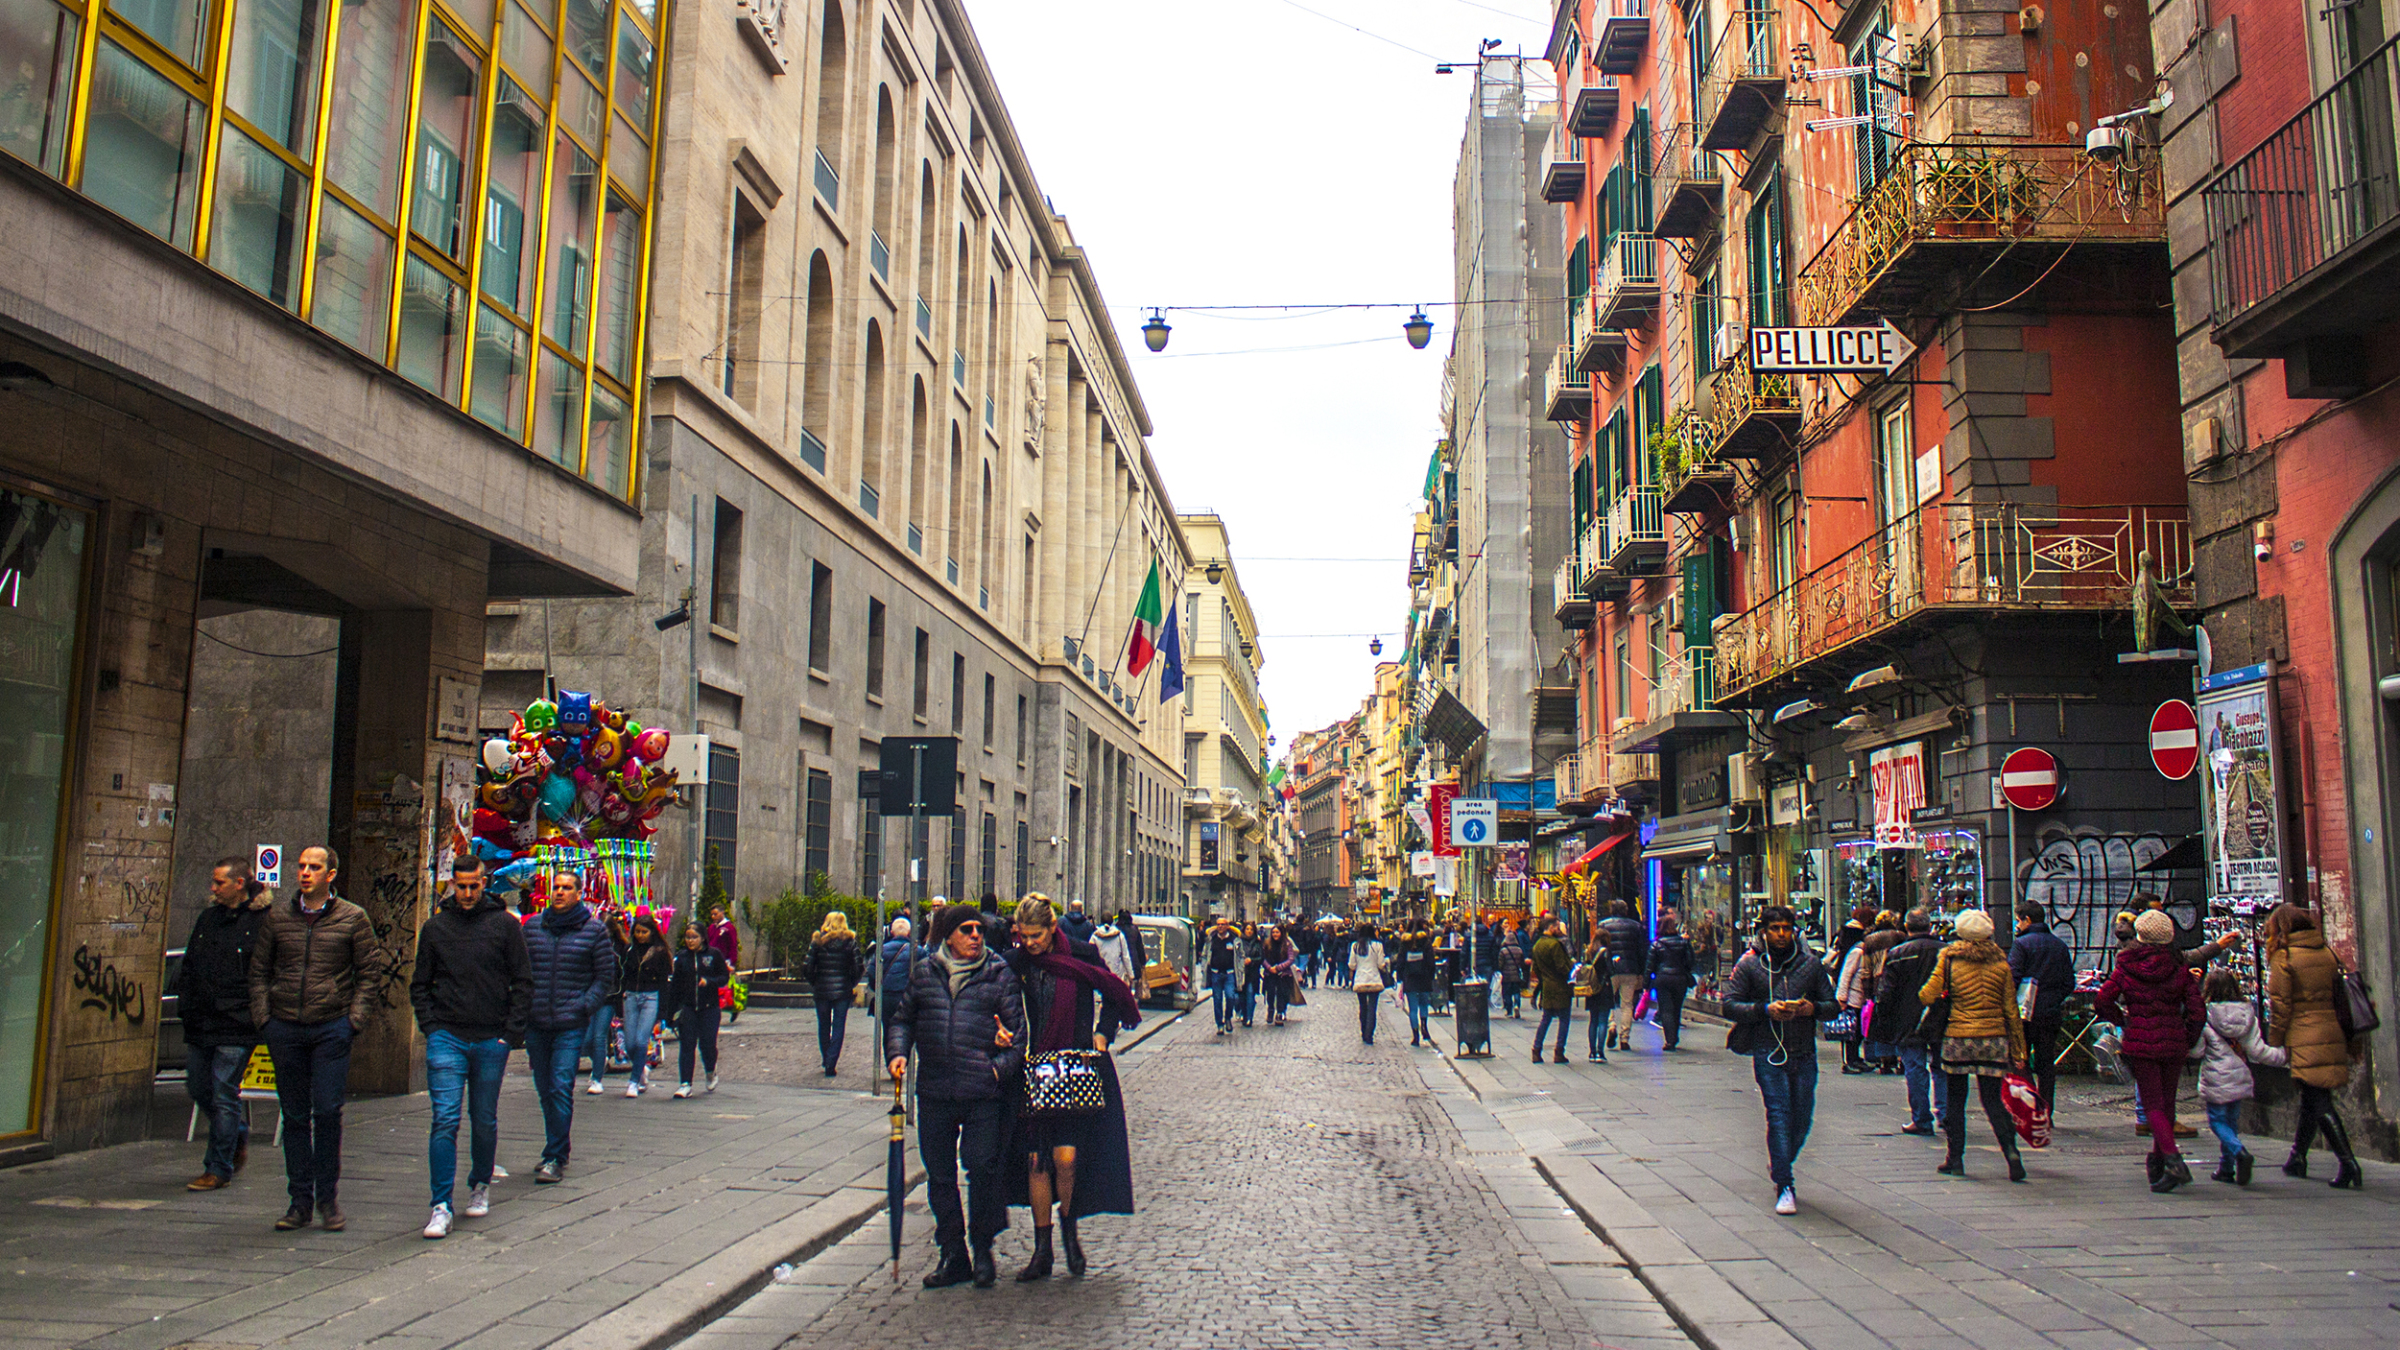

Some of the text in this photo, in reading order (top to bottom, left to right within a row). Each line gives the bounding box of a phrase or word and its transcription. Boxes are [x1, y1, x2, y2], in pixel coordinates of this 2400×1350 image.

[1754, 329, 1894, 366] PELLICCE
[2235, 711, 2260, 727] Giuseppe
[2223, 725, 2266, 751] Giacobazzi
[2245, 755, 2266, 771] sarò
[1456, 809, 1492, 817] pedonale
[2230, 860, 2278, 875] TEATRO ACACIA
